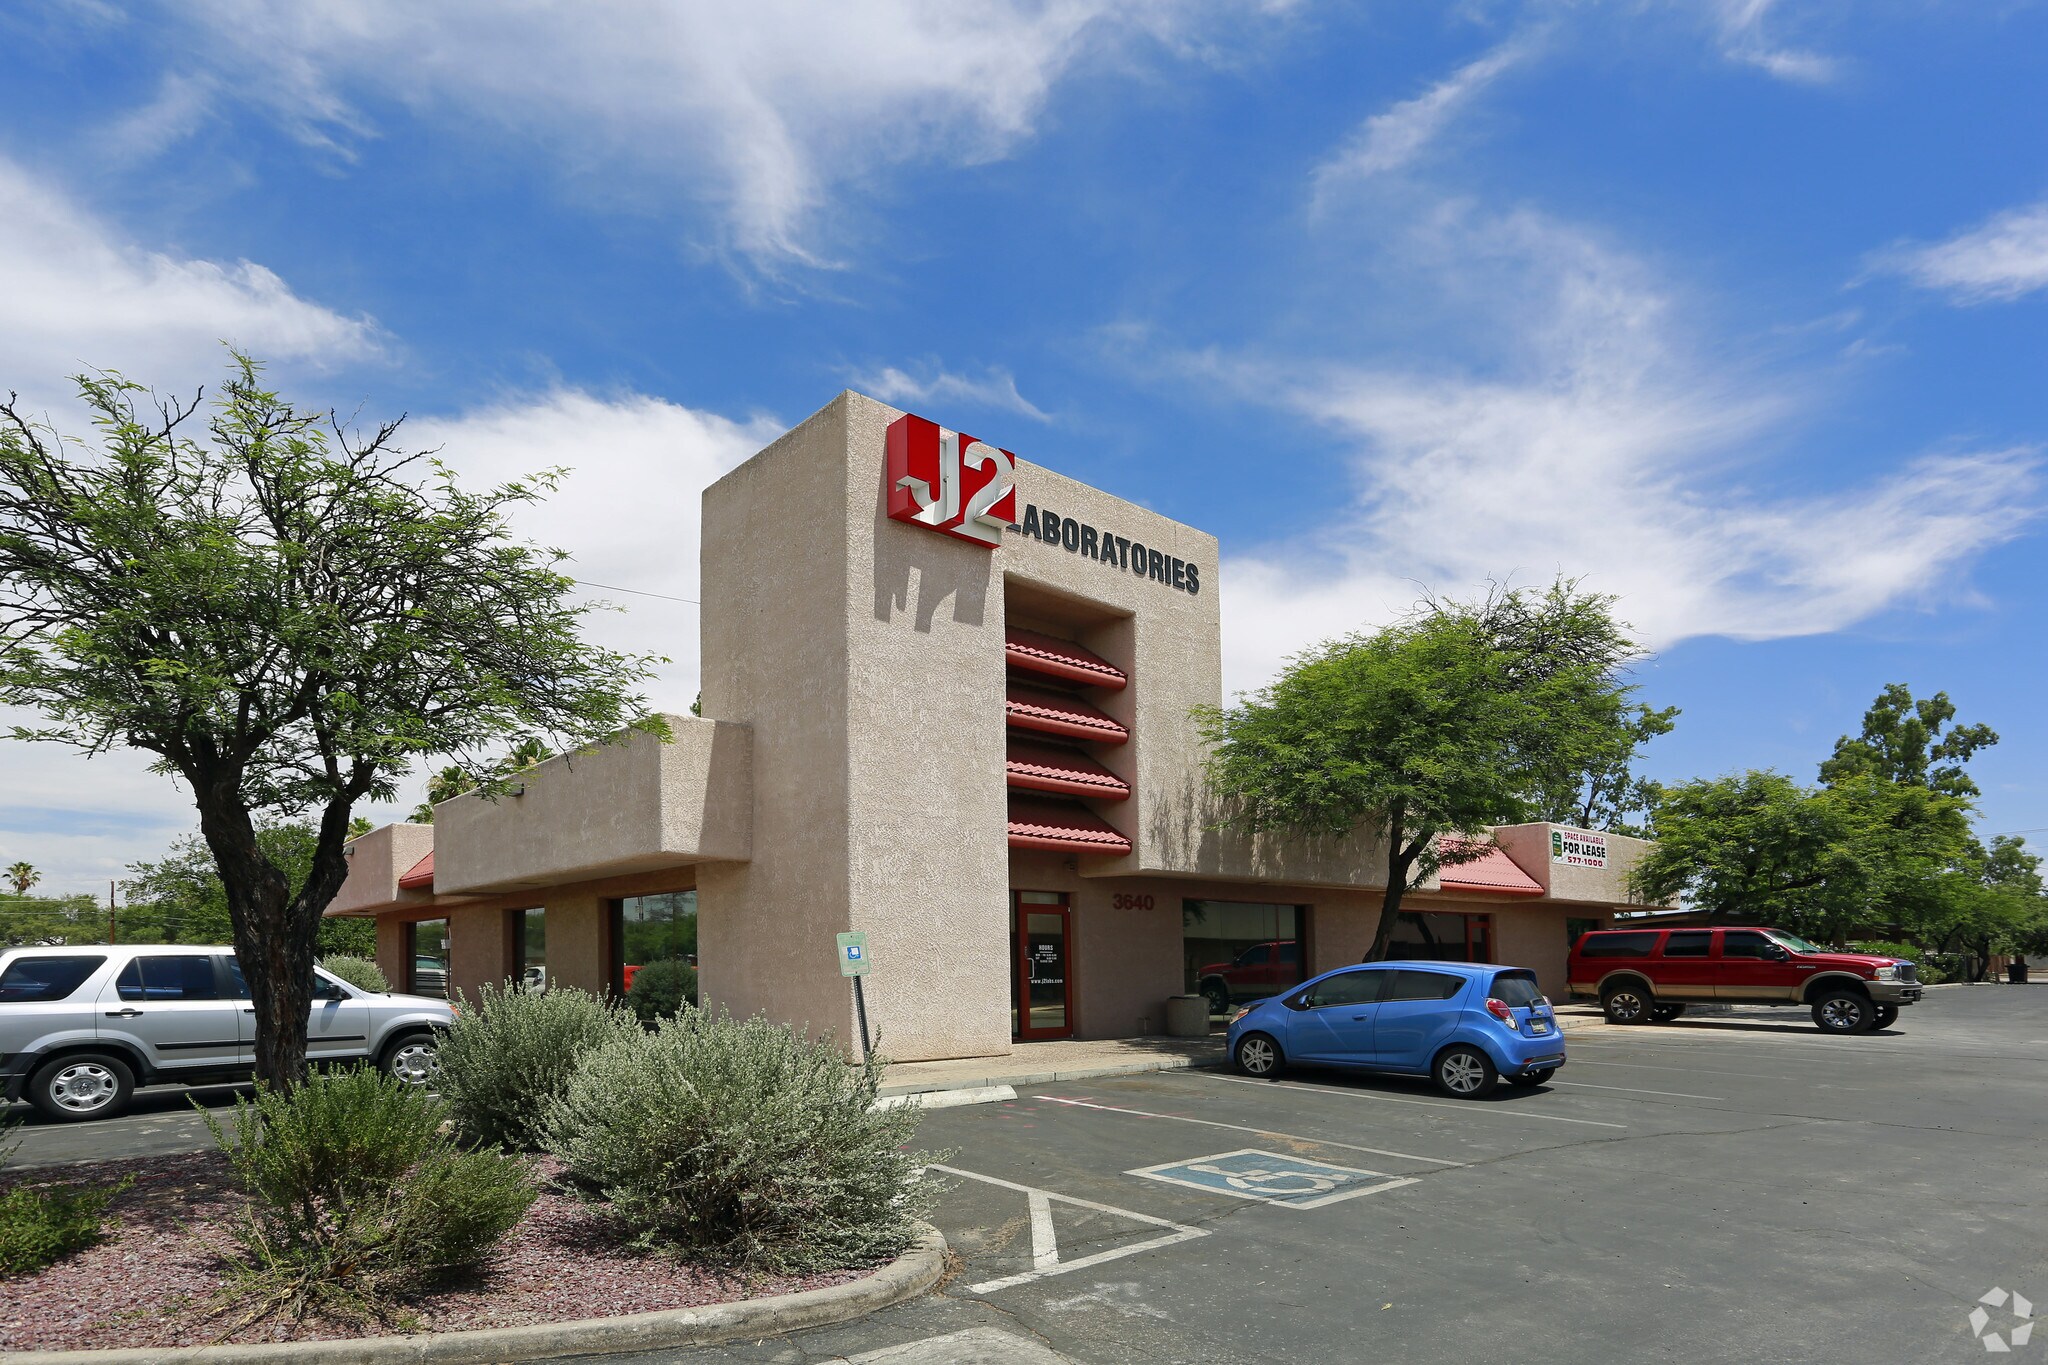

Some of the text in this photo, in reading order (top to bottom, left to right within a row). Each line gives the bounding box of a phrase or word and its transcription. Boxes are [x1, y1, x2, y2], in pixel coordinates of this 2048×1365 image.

[894, 428, 1199, 594] J2 ABORATORIES
[1564, 832, 1579, 841] SPACE
[1580, 835, 1604, 845] AVAILABLE
[1563, 841, 1606, 858] FOR LEASE
[1112, 893, 1155, 911] 3640
